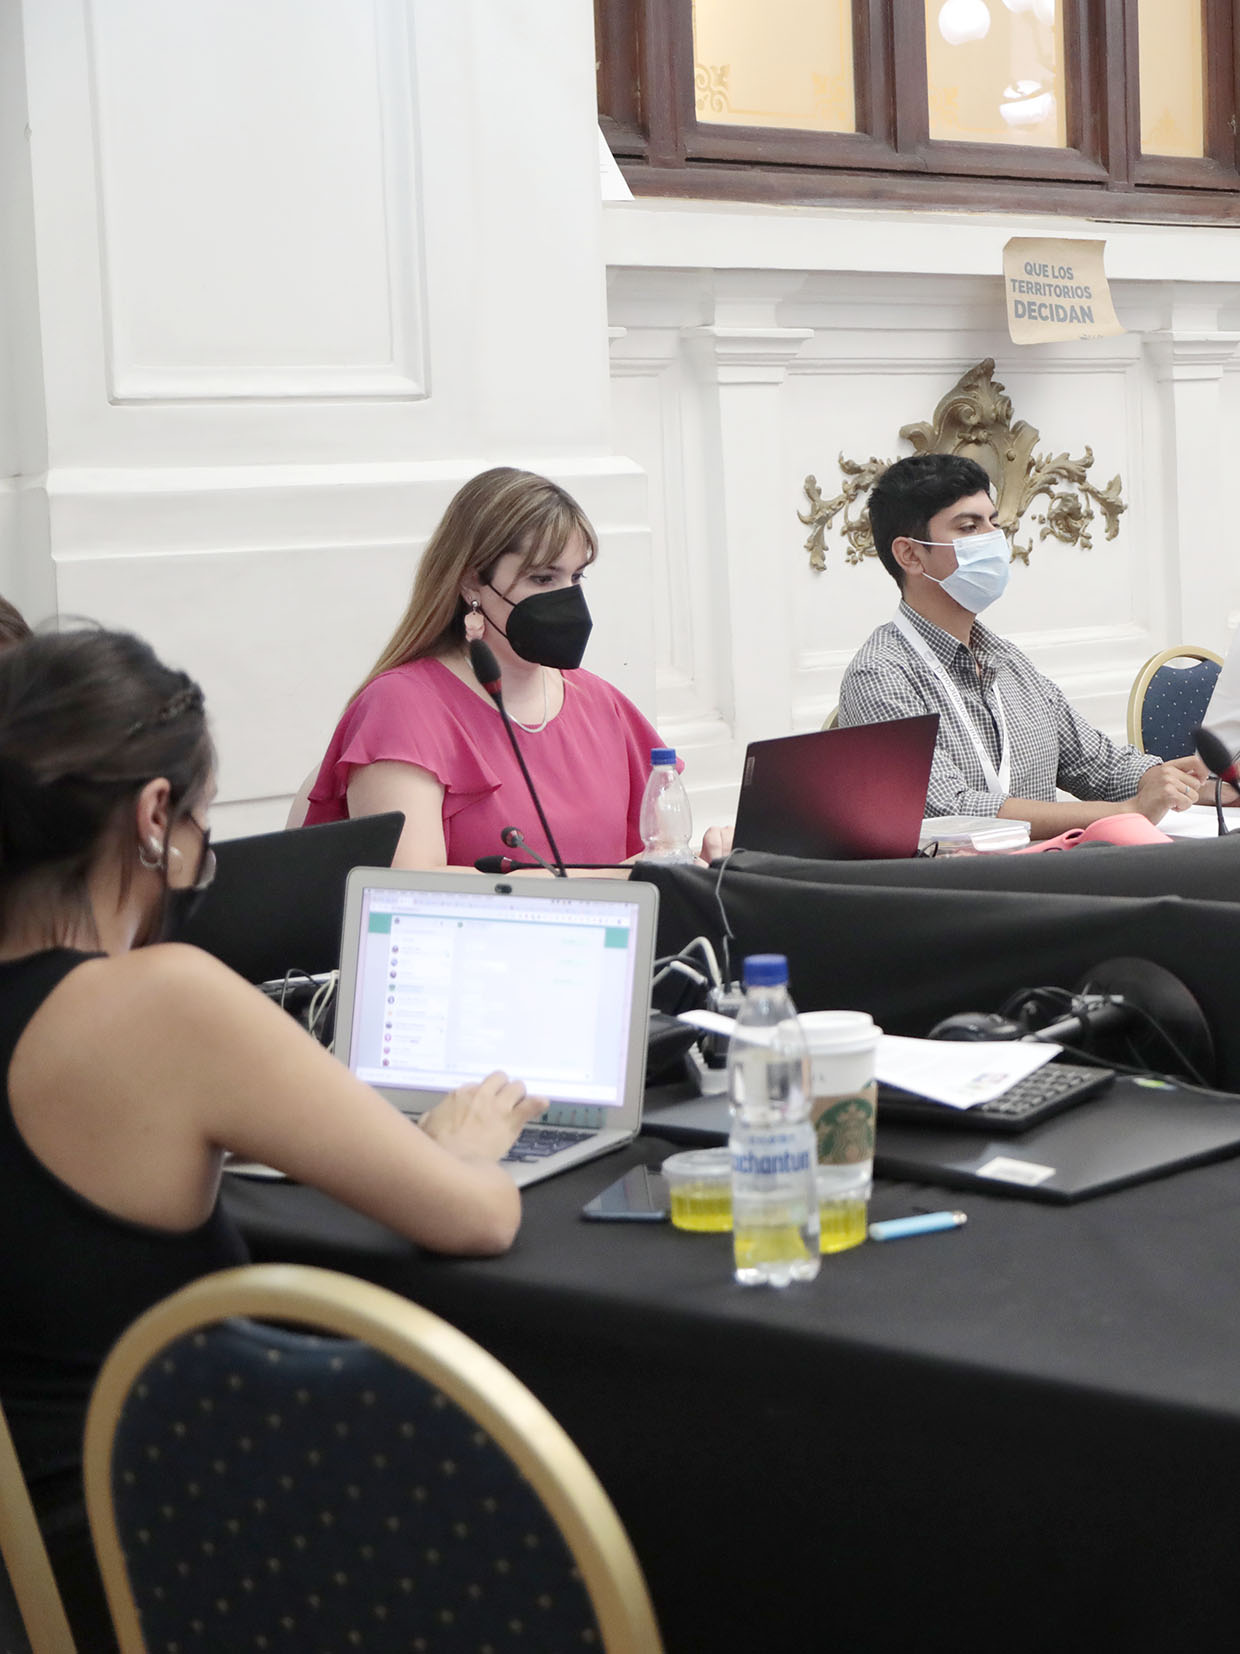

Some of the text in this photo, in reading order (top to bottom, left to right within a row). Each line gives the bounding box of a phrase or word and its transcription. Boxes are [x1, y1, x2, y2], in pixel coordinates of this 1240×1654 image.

[1024, 261, 1074, 280] QUE LOS
[1010, 278, 1092, 299] TERRITORIOS
[1014, 299, 1095, 323] DECIDAN
